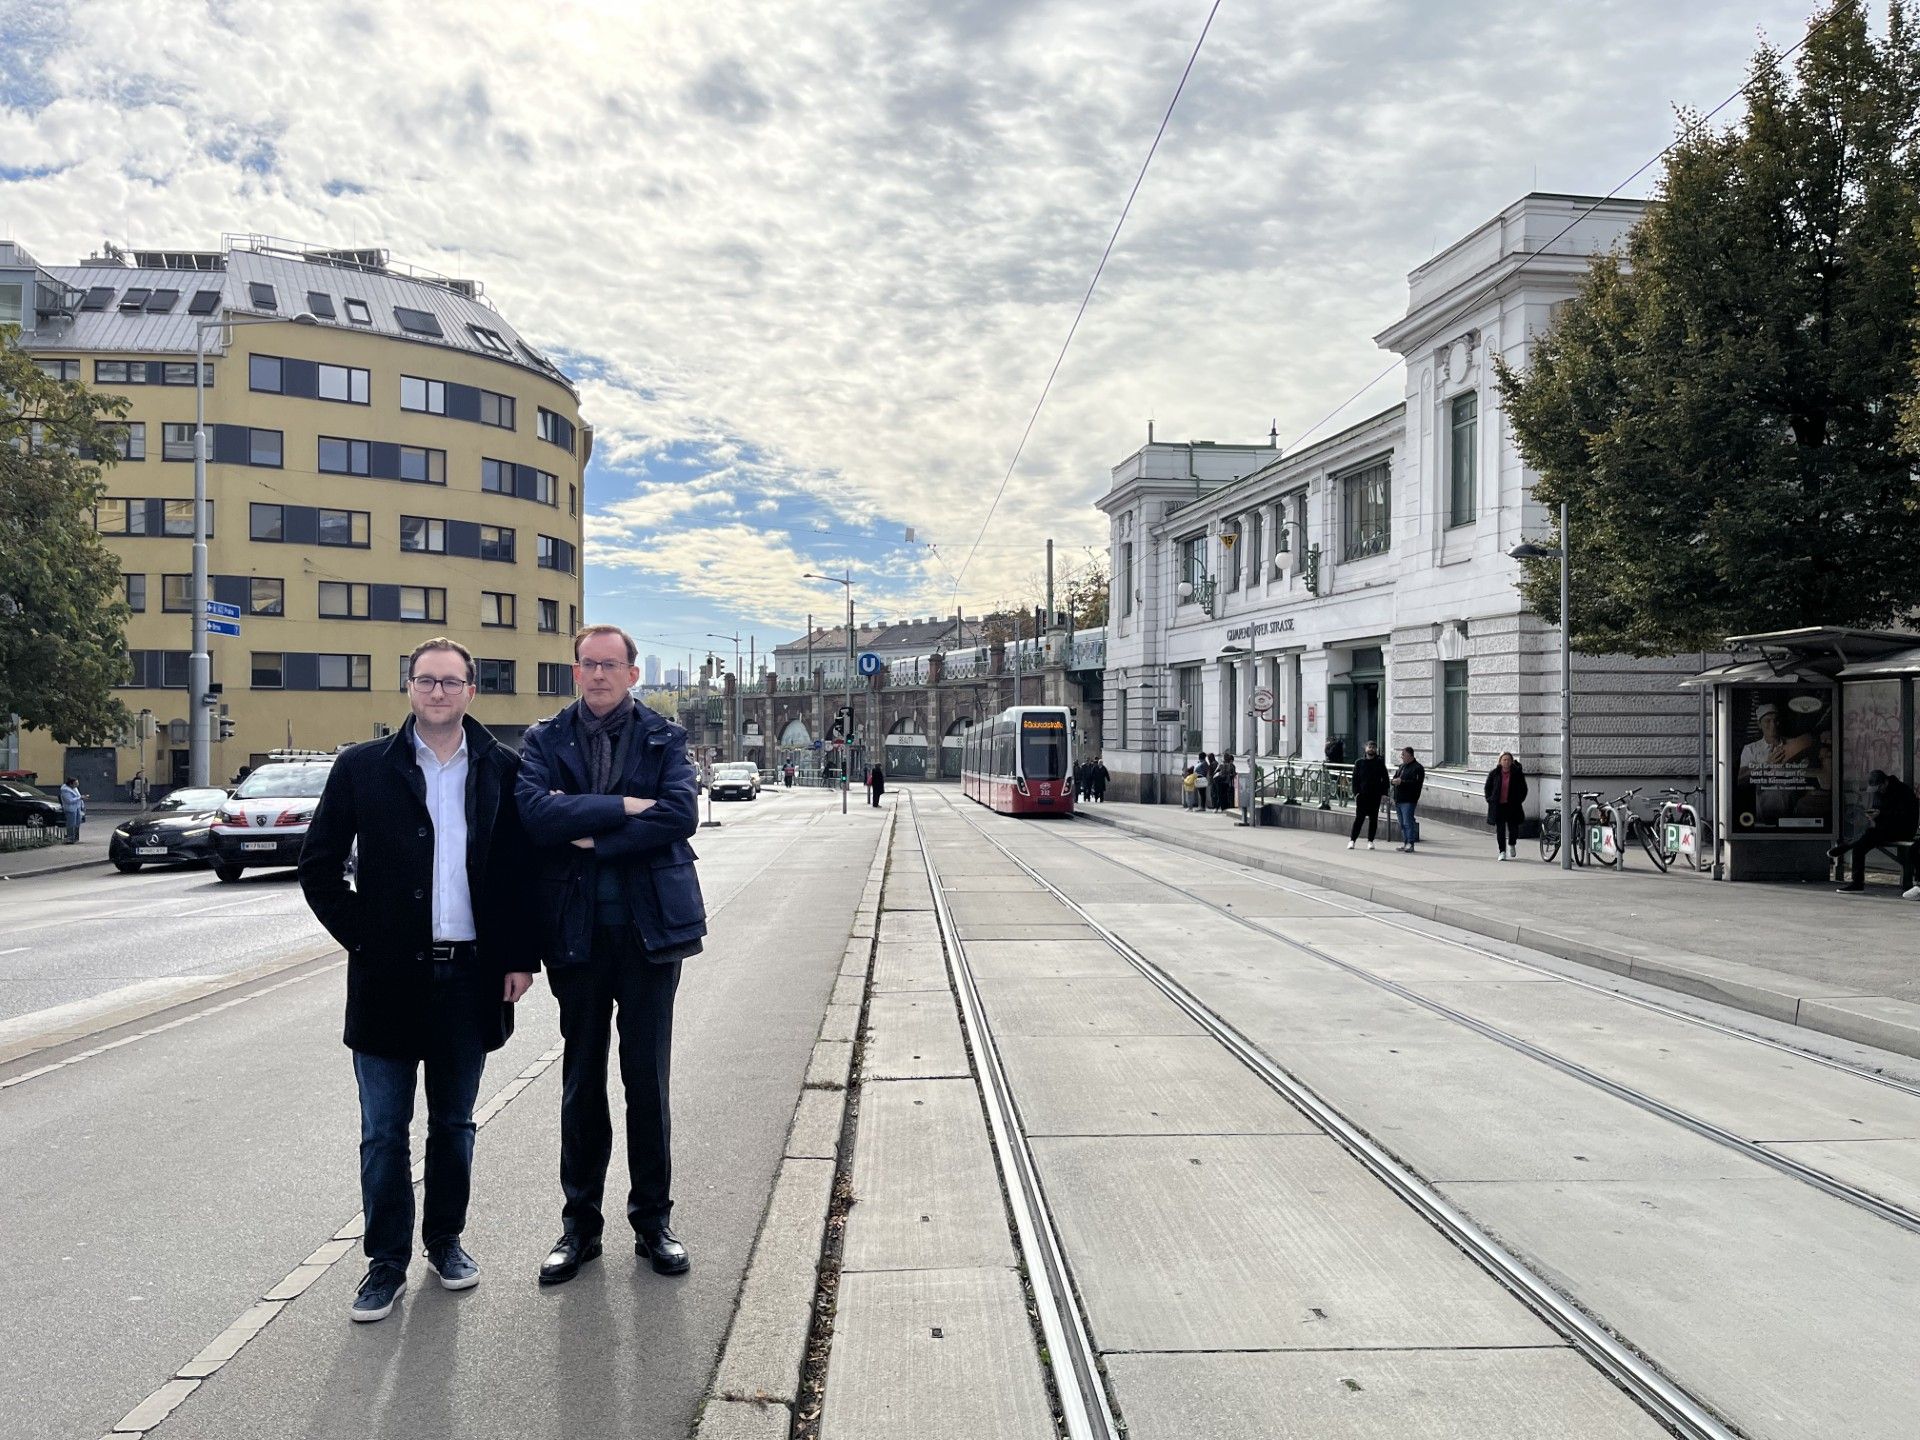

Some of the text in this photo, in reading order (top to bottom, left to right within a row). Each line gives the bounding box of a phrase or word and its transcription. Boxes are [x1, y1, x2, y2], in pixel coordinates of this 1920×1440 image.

[1224, 536, 1233, 545] 15
[1226, 618, 1294, 641] GUMPENDRFER STRASSE
[863, 657, 876, 672] U
[1591, 828, 1600, 850] P
[1667, 826, 1677, 849] P
